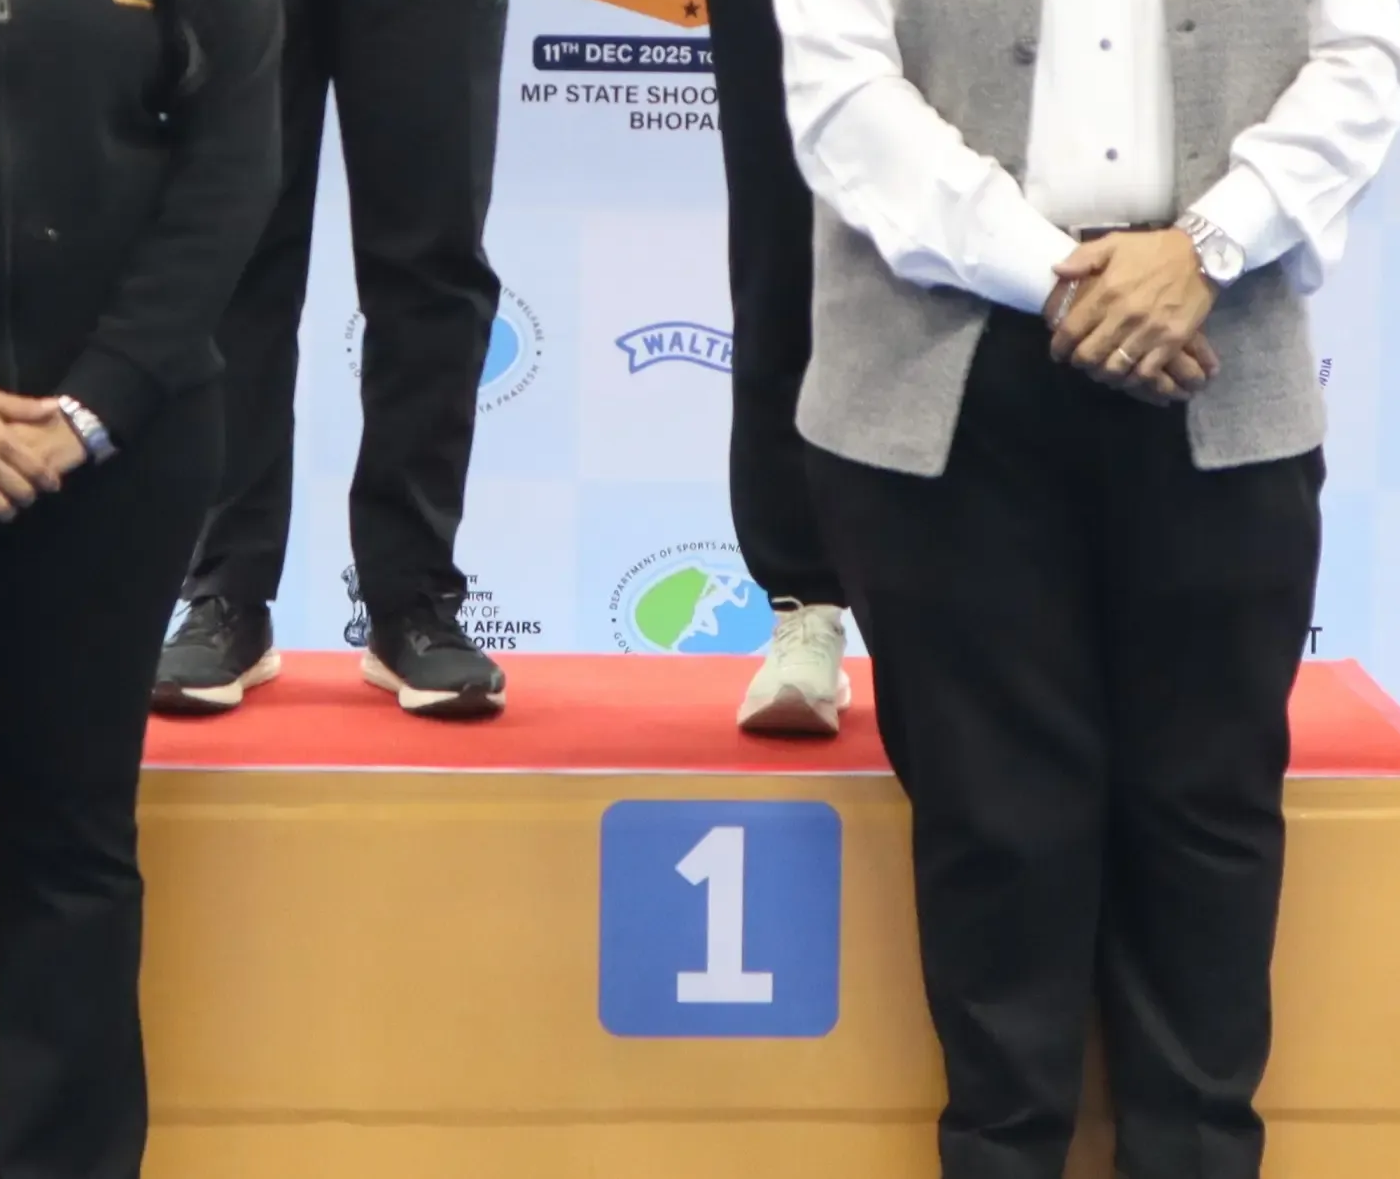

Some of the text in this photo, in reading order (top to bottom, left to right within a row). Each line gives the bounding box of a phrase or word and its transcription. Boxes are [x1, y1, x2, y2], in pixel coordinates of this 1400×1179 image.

[543, 42, 579, 62] 11TH
[585, 44, 633, 63] DEC
[639, 45, 692, 64] 2025
[521, 84, 717, 104] MP STATE SHOO
[630, 111, 719, 130] BHOPA
[517, 298, 544, 341] WELFARE
[642, 331, 732, 362] WALTH
[497, 364, 539, 406] PRADESH
[609, 553, 656, 611] DEPARTMENT
[660, 547, 672, 559] OF
[676, 542, 717, 553] SPORTS
[482, 606, 500, 618] OF
[474, 621, 542, 634] AFFAIRS
[474, 637, 516, 650] ORTS
[675, 826, 773, 1003] 1
